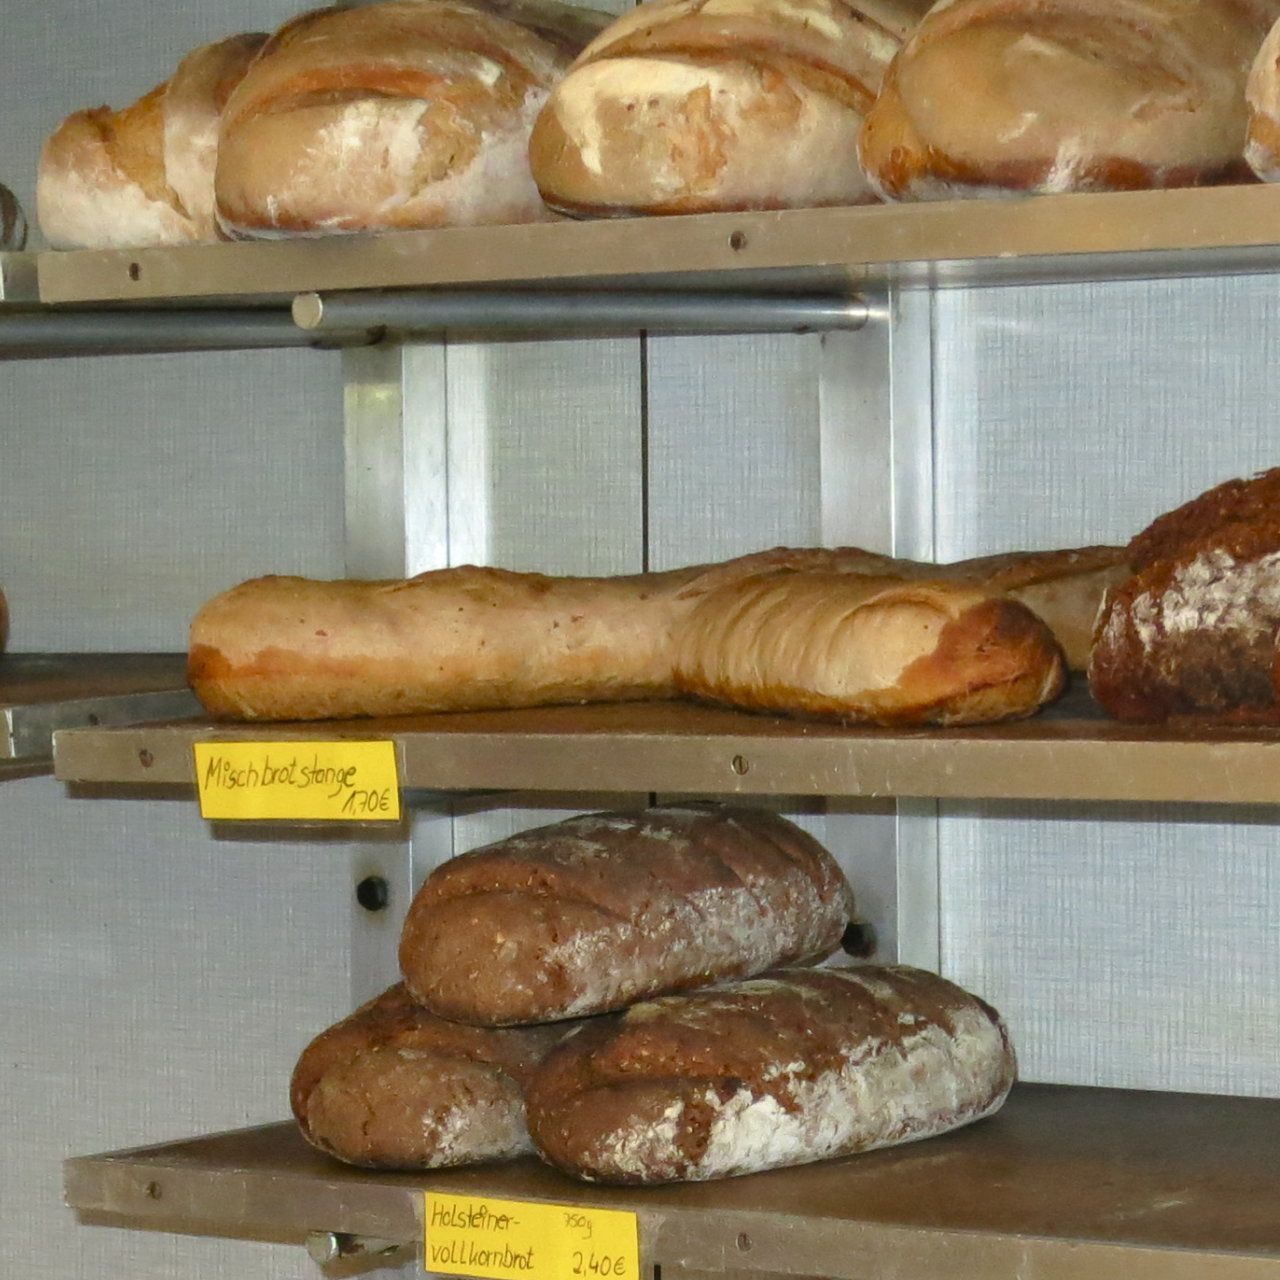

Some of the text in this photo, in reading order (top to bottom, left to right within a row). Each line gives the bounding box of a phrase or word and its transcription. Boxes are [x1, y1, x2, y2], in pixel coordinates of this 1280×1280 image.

[204, 754, 357, 798] Mischbrotstange
[342, 788, 390, 815] 1,70€
[572, 1250, 626, 1277] 2,40€
